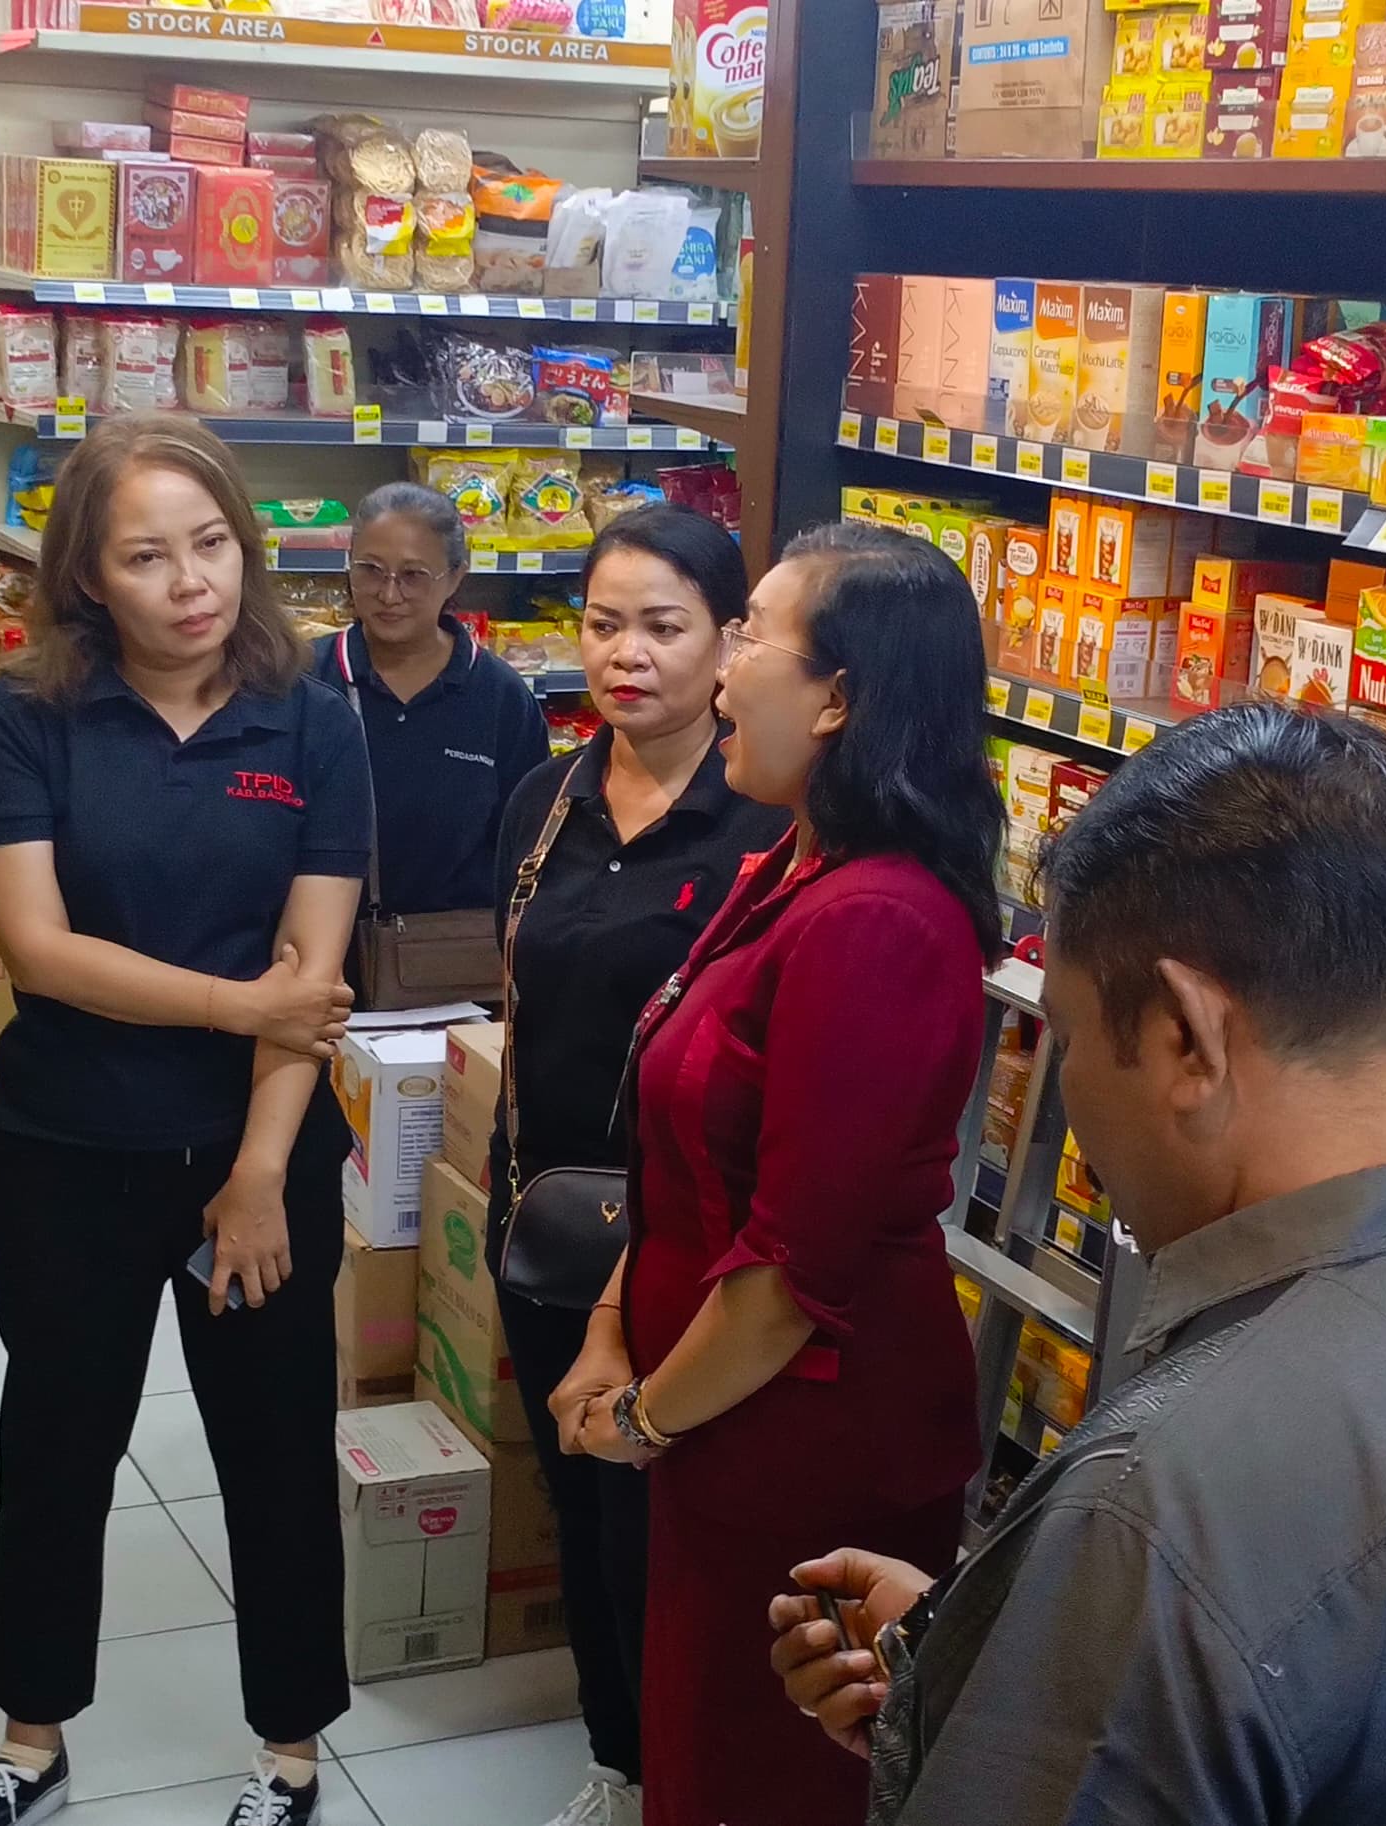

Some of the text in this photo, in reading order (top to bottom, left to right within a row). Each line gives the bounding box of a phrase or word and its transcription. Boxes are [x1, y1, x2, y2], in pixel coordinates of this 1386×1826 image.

[127, 11, 286, 40] STOCK AREA
[464, 34, 609, 61] STOCK AREA
[706, 32, 764, 70] Coffe
[724, 57, 764, 84] mat
[997, 292, 1027, 314] Maxim
[1040, 297, 1073, 319] Maxim
[1087, 301, 1124, 323] Maxim
[233, 771, 295, 794] TPID
